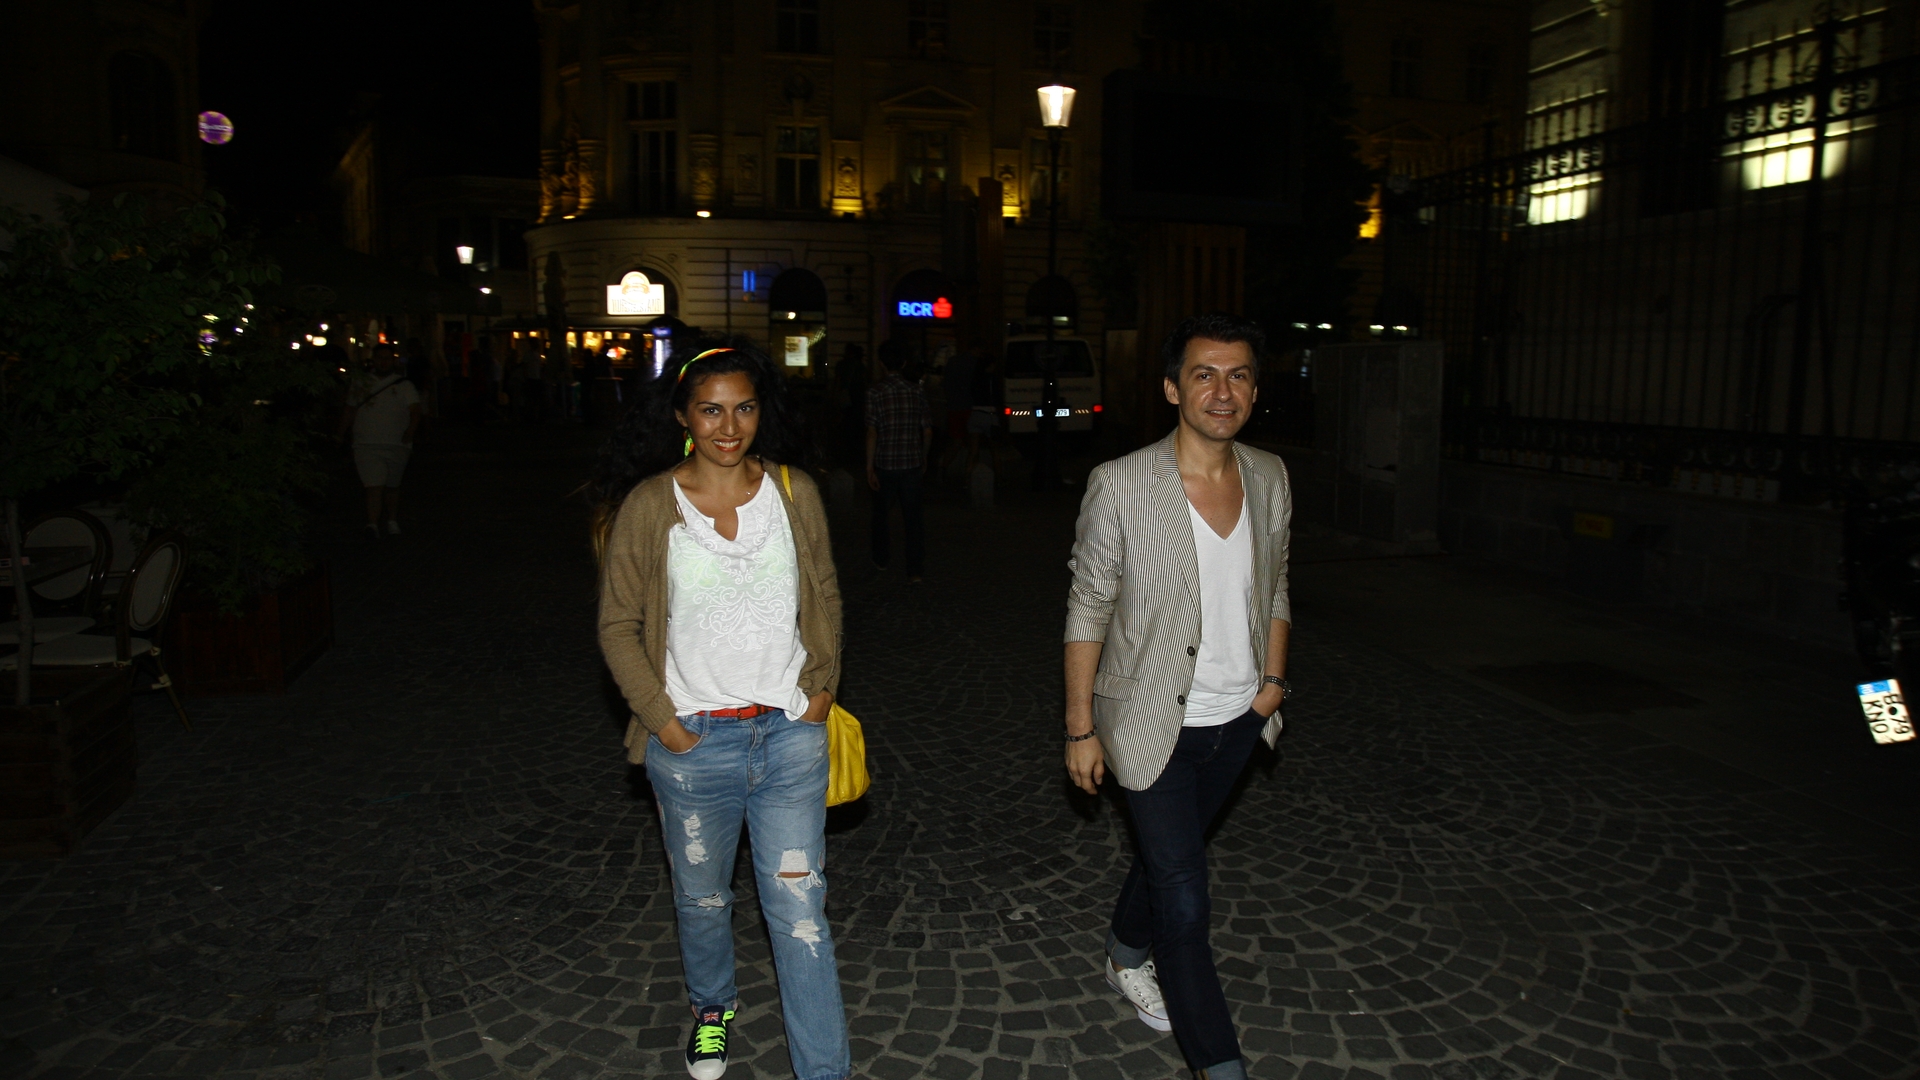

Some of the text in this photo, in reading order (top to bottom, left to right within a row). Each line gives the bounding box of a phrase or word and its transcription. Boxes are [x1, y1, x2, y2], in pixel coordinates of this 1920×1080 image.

[898, 301, 933, 317] BCR
[1862, 699, 1888, 734] KNO
[1890, 715, 1910, 734] 79
